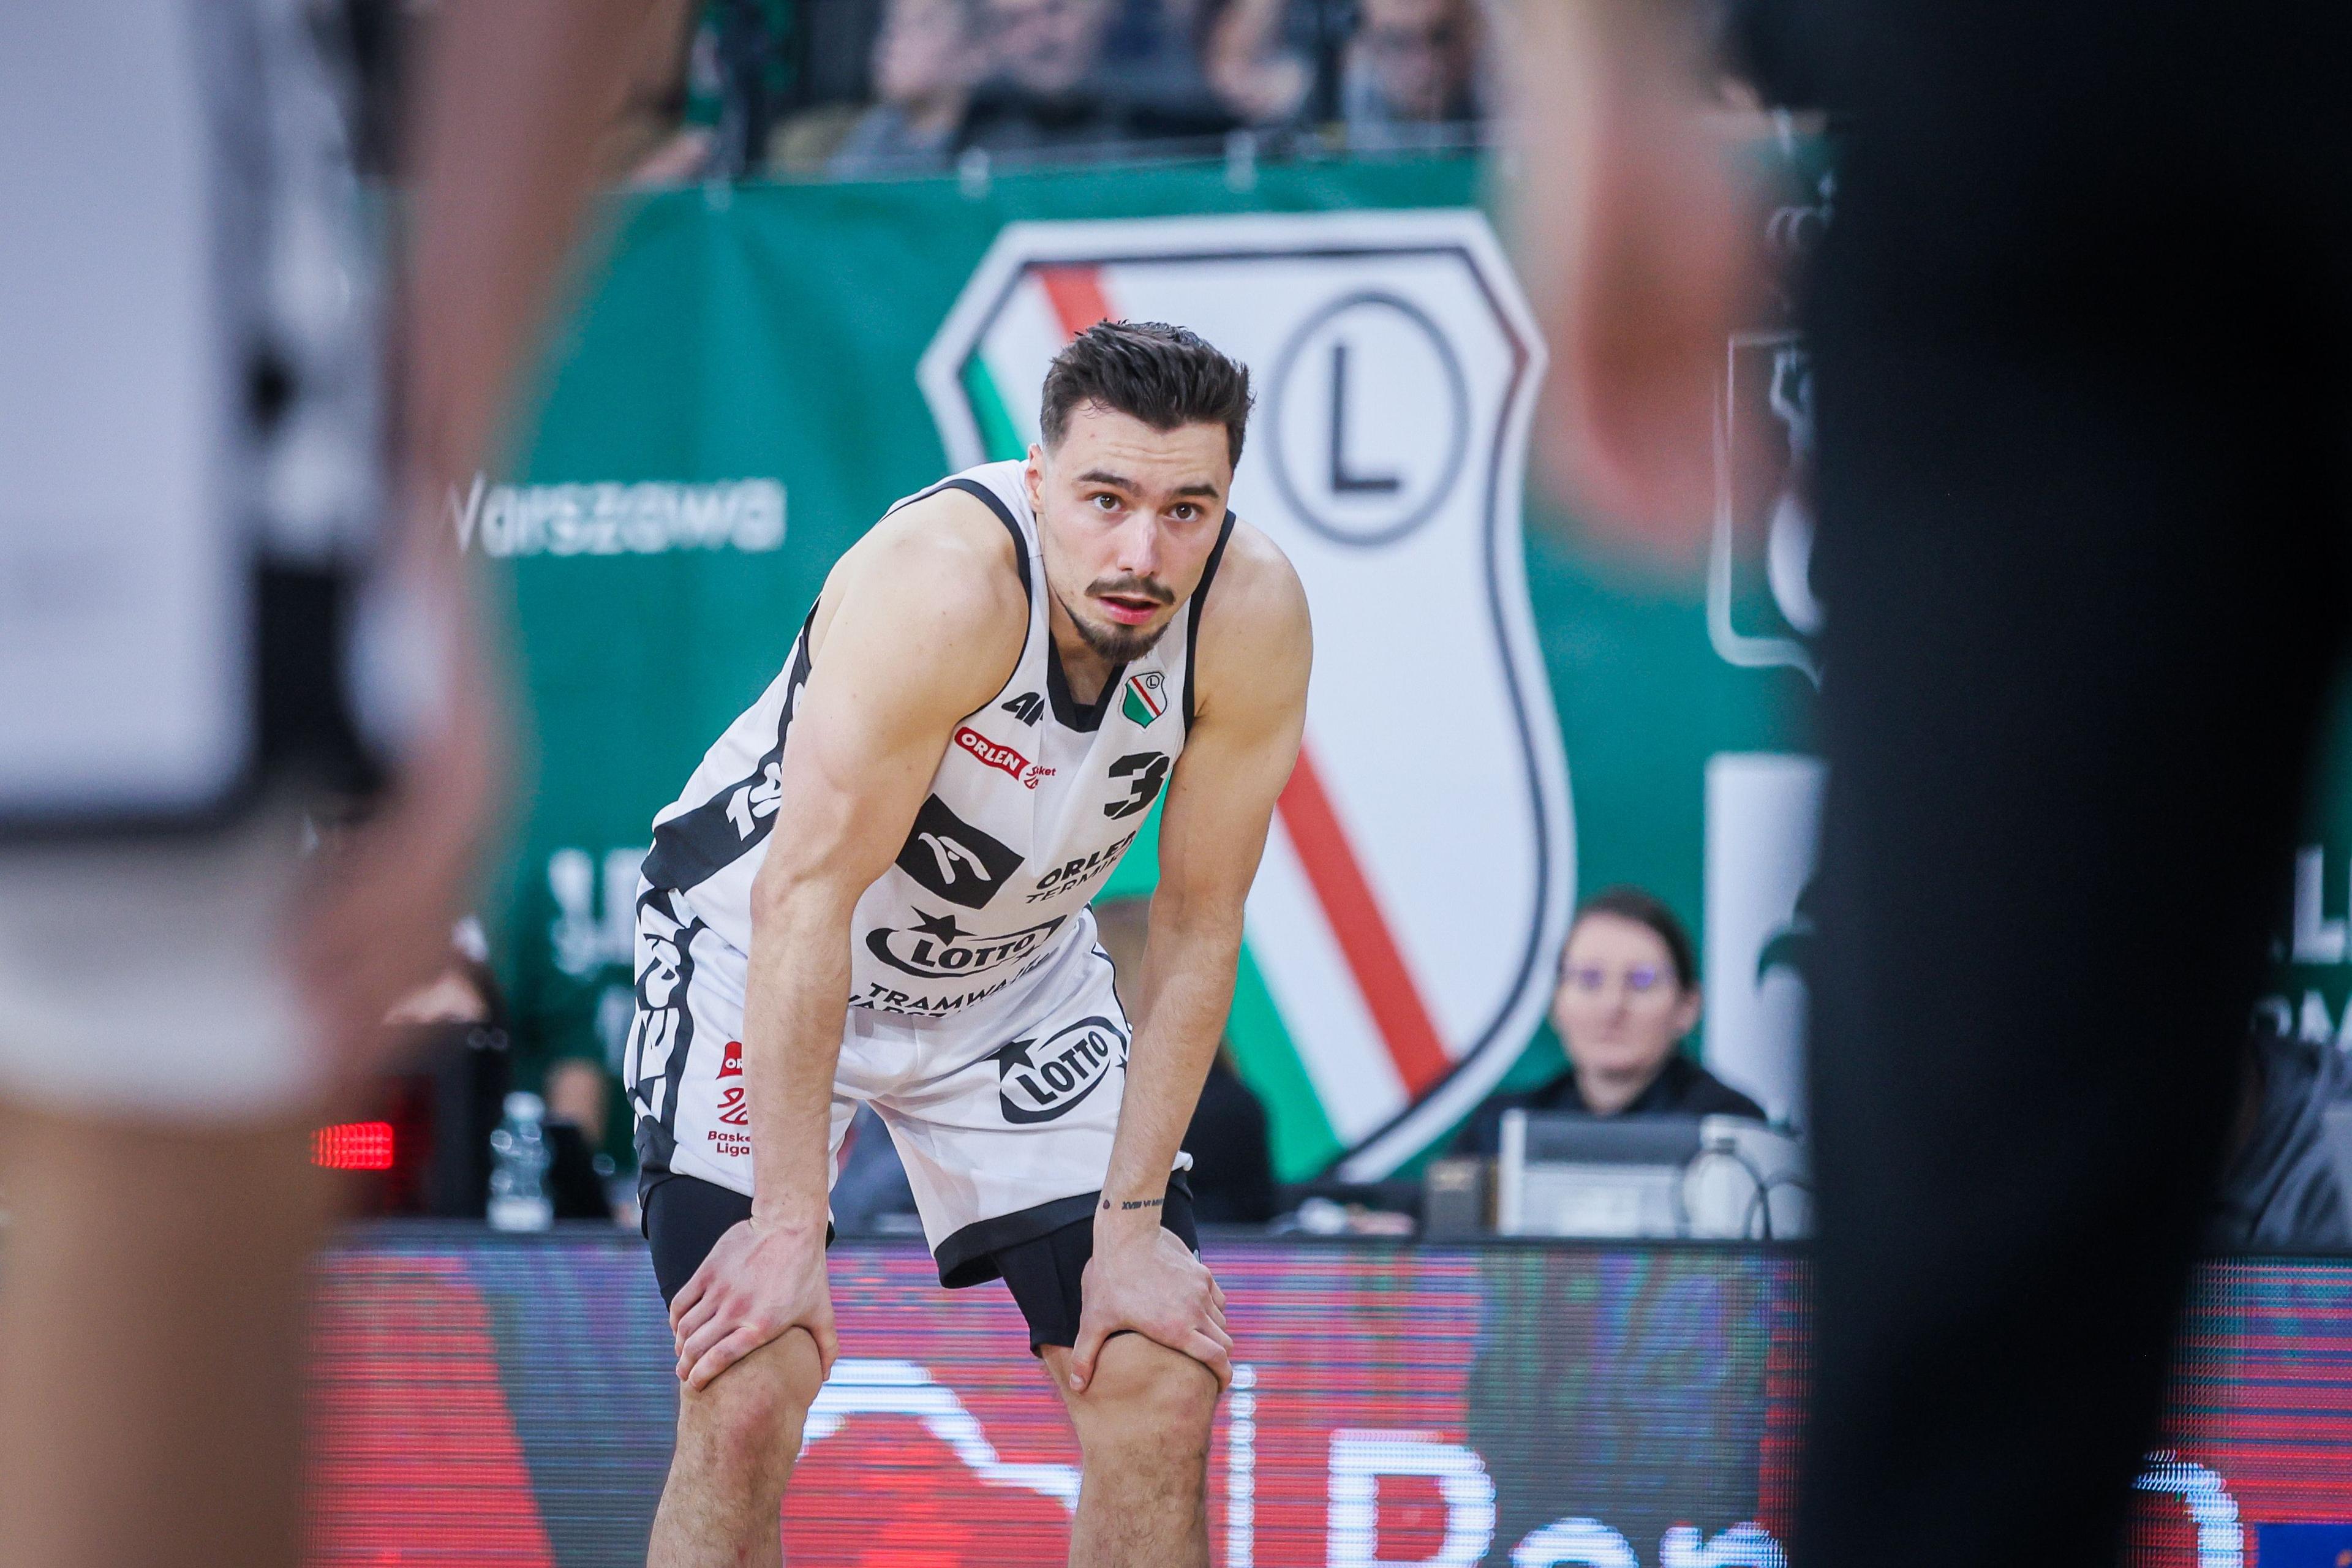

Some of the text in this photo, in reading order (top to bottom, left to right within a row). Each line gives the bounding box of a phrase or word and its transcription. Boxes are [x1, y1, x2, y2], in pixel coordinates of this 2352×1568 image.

[961, 733, 1020, 771] ORLEN
[1103, 751, 1170, 820] 3
[911, 933, 1036, 969] LOTTO
[1015, 1031, 1109, 1106] LOTTO
[717, 1143, 750, 1157] Liga
